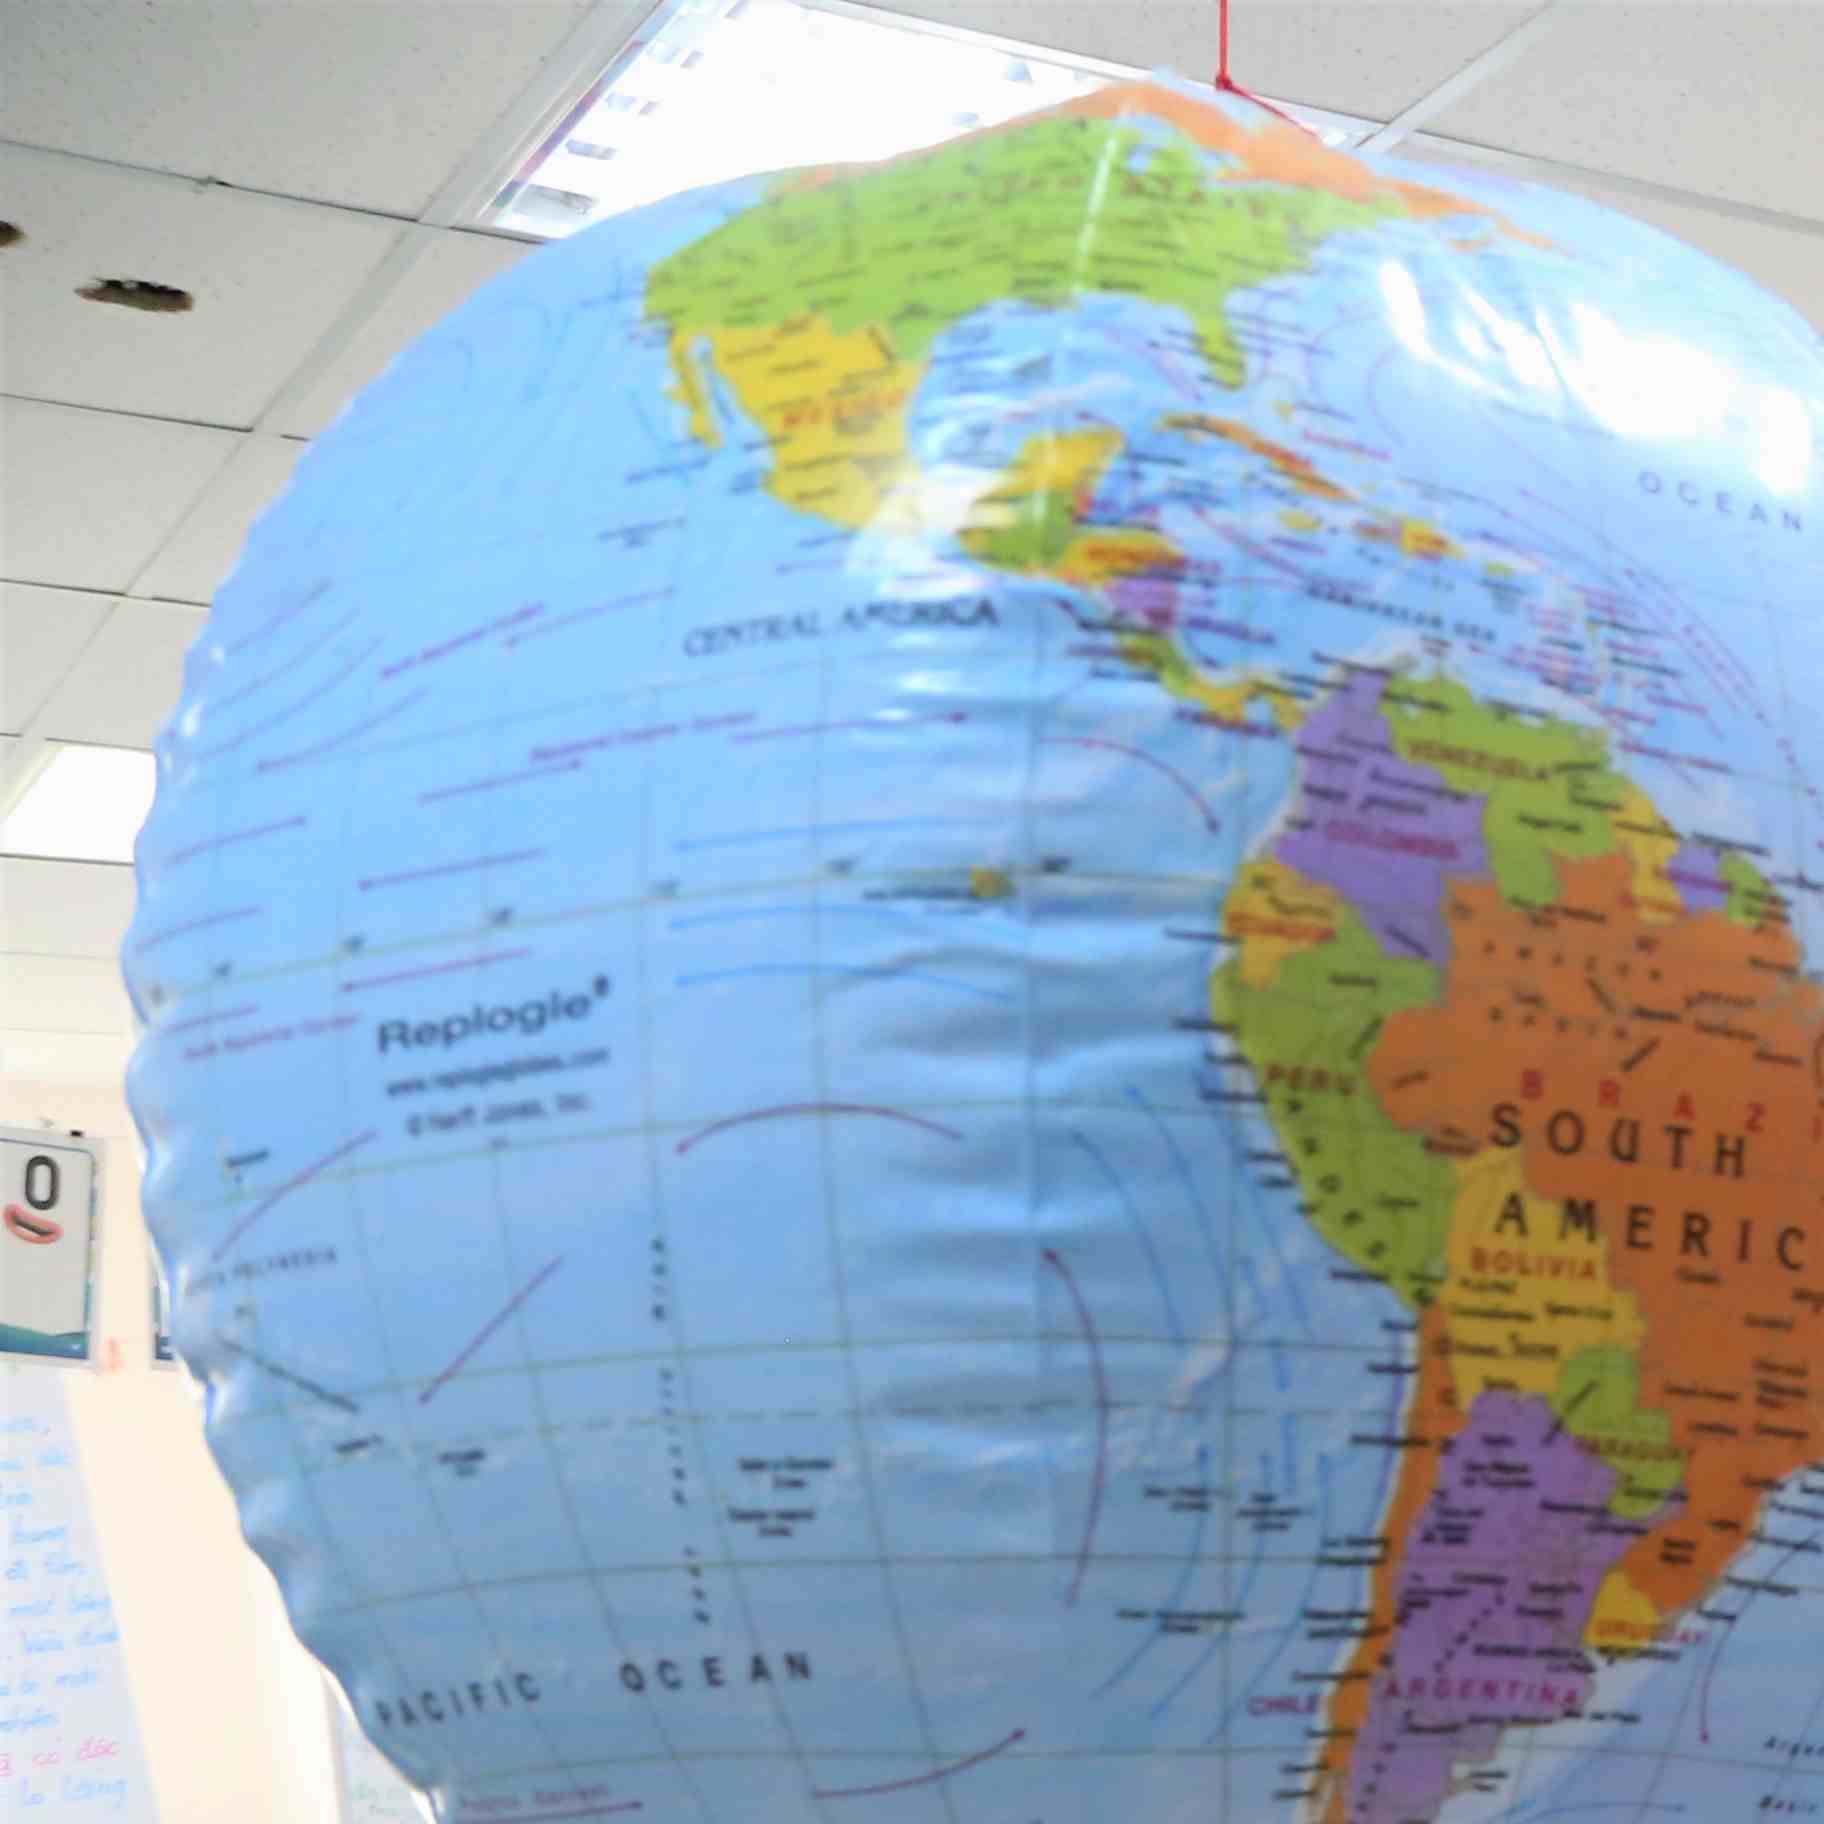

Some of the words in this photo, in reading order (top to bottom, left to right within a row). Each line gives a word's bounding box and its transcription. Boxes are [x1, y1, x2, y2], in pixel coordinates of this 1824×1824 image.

[1639, 470, 1803, 532] OCEAN
[376, 988, 592, 1054] Replogle
[1266, 1063, 1356, 1096] PERU
[1489, 1102, 1746, 1179] SOUTH
[1470, 1246, 1597, 1281] BOLIVIA
[376, 1671, 543, 1728] PACIFIC
[619, 1651, 812, 1693] OCEAN
[1247, 1695, 1319, 1716] CHILE
[1384, 1678, 1580, 1708] ARGENTINA
